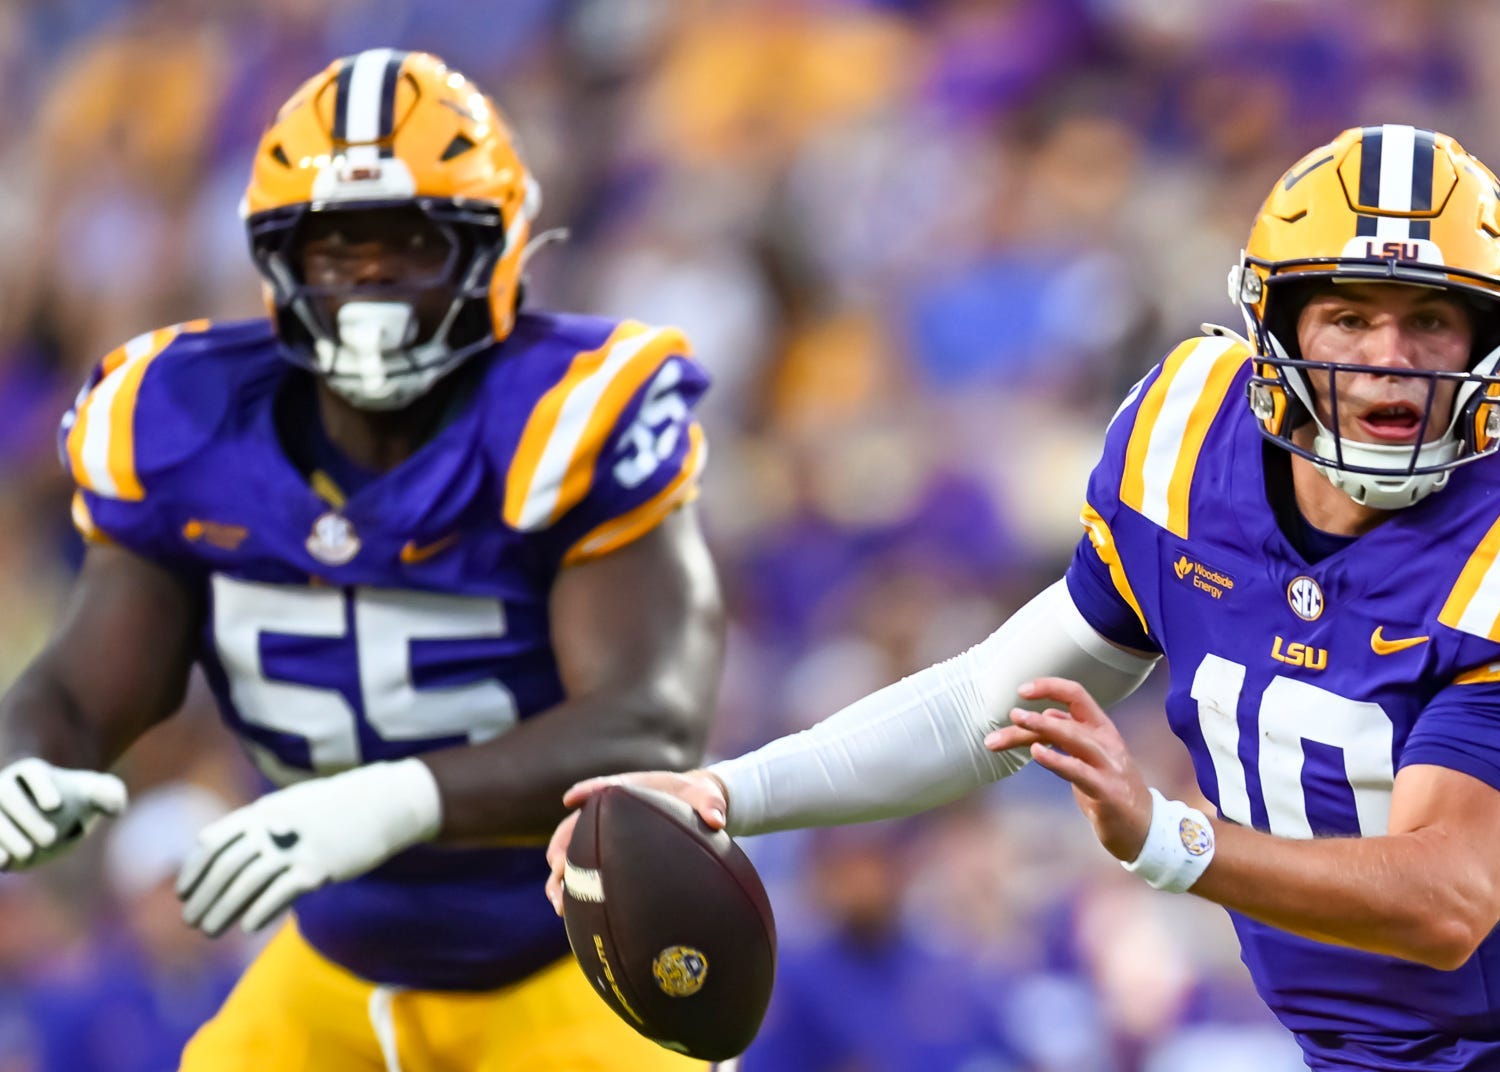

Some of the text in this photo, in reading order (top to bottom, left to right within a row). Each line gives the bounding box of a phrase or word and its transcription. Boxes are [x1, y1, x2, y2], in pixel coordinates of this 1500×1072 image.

[1366, 241, 1419, 261] LSU
[1193, 575, 1223, 599] Energy
[1194, 562, 1235, 590] Woodside
[1289, 577, 1322, 619] SEC
[1271, 636, 1328, 671] LSU
[211, 571, 518, 790] 55
[1190, 652, 1394, 841] 10
